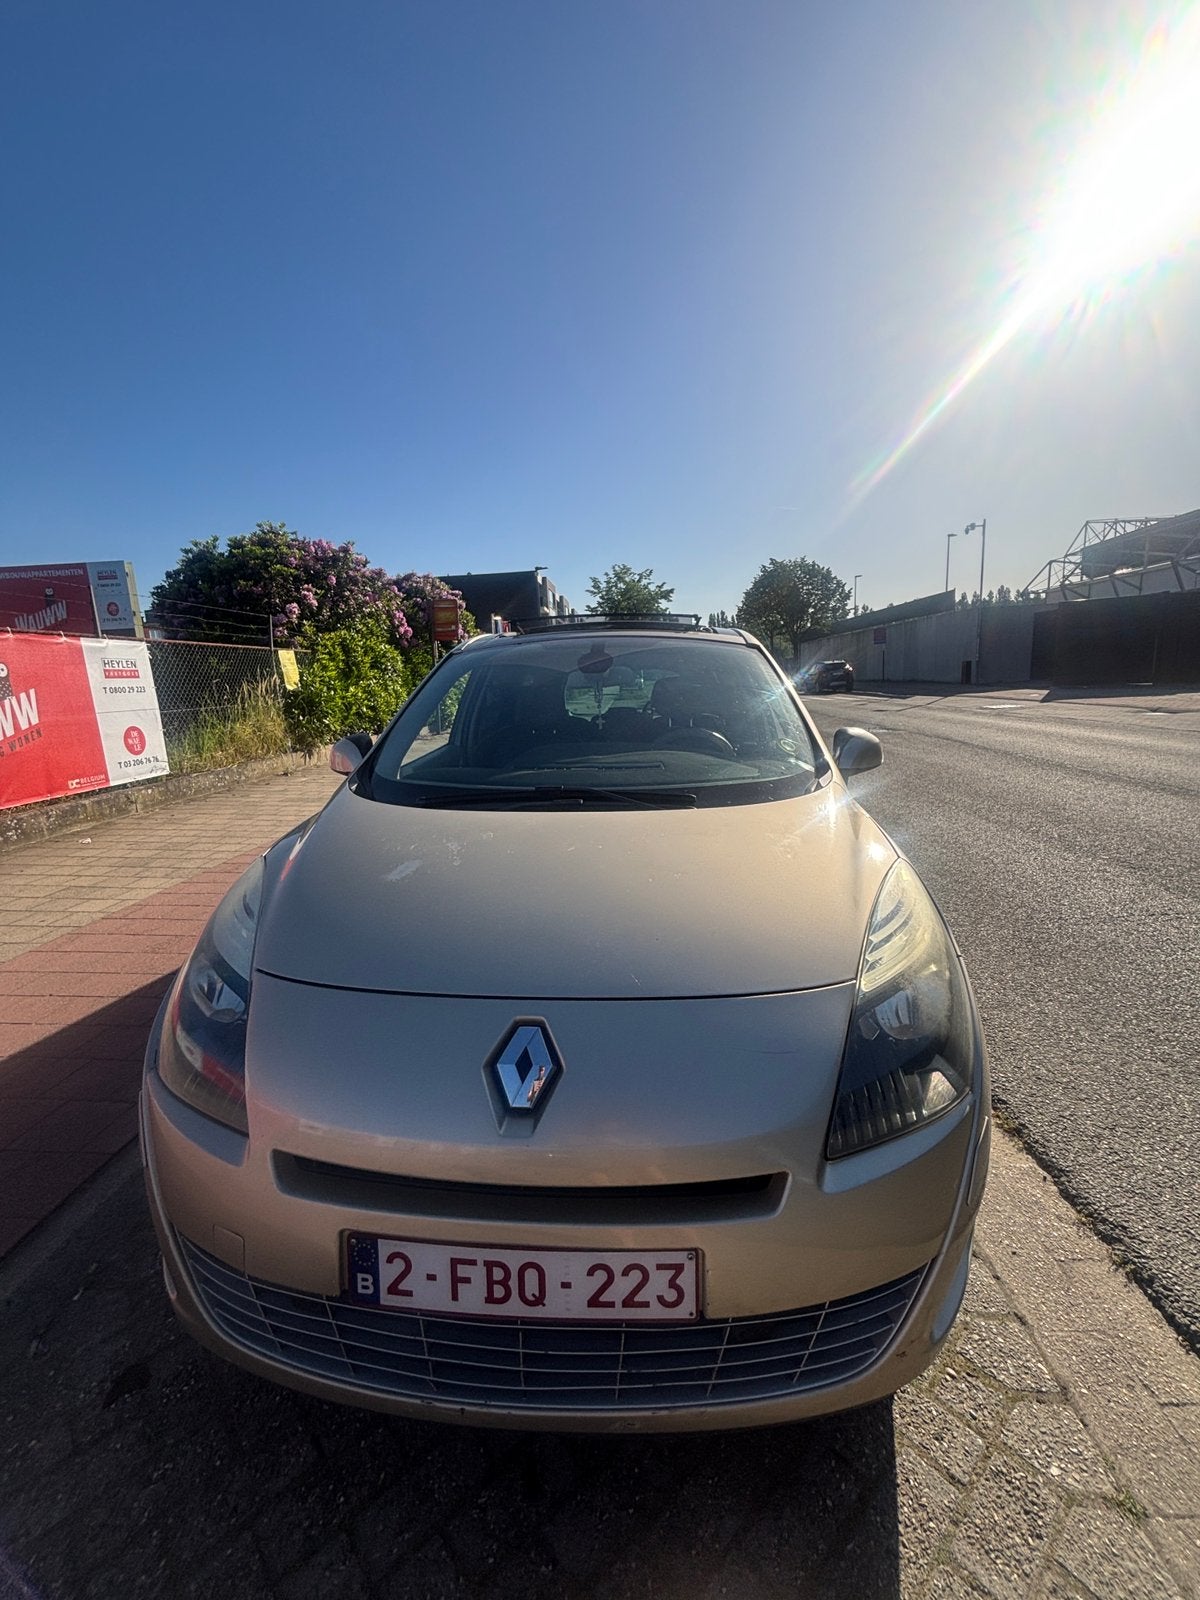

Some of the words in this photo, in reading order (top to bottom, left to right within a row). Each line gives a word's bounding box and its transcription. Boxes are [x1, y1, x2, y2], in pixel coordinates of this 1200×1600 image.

[15, 599, 67, 630] WAUWW
[103, 659, 137, 669] HEYLEN
[108, 686, 127, 694] 0800
[127, 686, 135, 694] 29
[136, 686, 146, 694] 223
[8, 729, 42, 752] WONEN
[118, 761, 123, 769] T
[123, 760, 132, 768] 03
[132, 758, 144, 767] 206
[80, 773, 106, 784] BELGIUM
[356, 1273, 375, 1295] B
[385, 1251, 687, 1310] 2-FBQ-223
